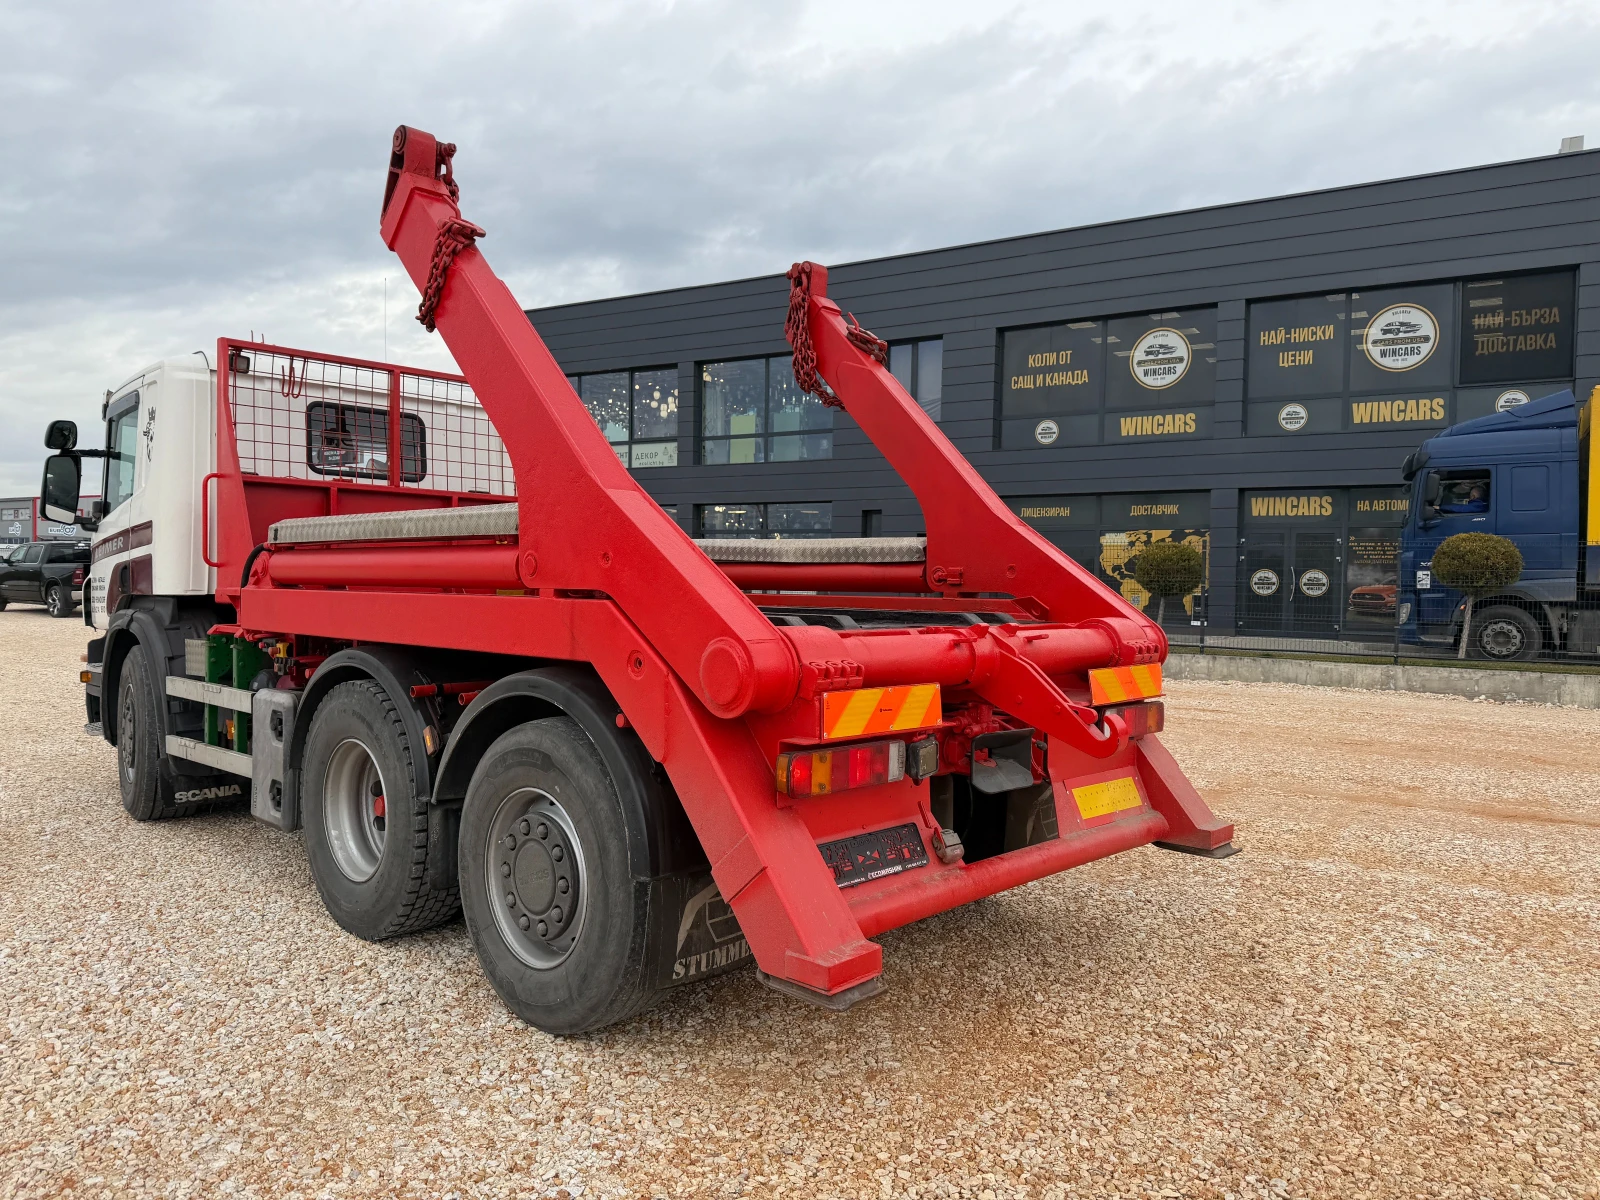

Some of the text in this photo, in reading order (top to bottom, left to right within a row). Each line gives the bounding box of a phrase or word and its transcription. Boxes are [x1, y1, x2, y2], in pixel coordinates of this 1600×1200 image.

[1473, 307, 1560, 330] НАЙ-БЪРЗА
[1260, 325, 1334, 346] НАЙ-НИСКИ
[1475, 332, 1557, 356] ДОСТАВКА
[1028, 350, 1073, 368] КОЛИ ОТ
[1279, 349, 1313, 368] ЦЕНИ
[1380, 346, 1422, 358] WINCARS
[1011, 369, 1089, 390] САЩ И КАНАДА
[1143, 366, 1177, 378] WINCARS
[1351, 397, 1445, 424] WINCARS
[1120, 413, 1196, 437] WINCARS
[635, 451, 659, 461] ДЕКОР
[1020, 506, 1070, 518] ЛИЦЕНЗИРАН
[1129, 504, 1179, 517] ДОСТАВЧИК
[1251, 495, 1333, 517] WINCARS
[1357, 500, 1371, 512] НА
[174, 784, 242, 803] SCANIA
[672, 938, 753, 980] STUMME
